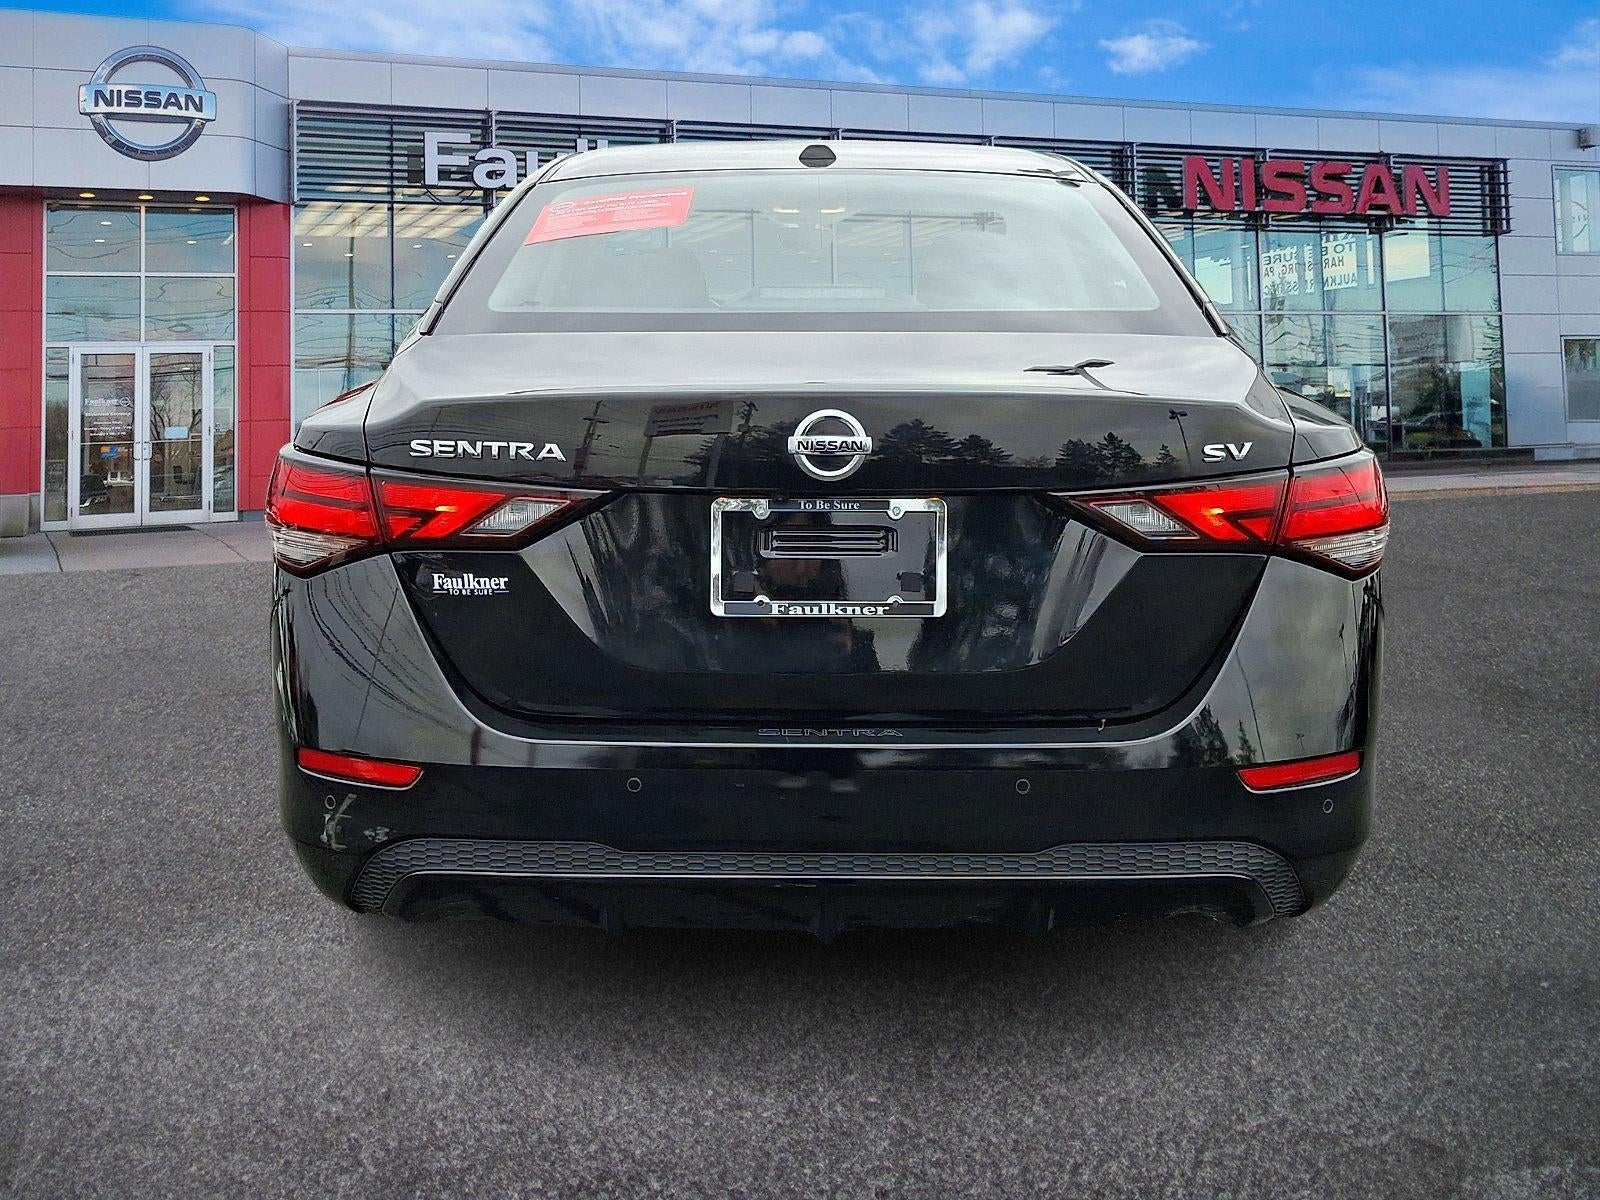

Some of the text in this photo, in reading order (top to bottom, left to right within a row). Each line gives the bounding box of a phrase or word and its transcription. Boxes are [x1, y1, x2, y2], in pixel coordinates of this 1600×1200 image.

[93, 89, 204, 113] NISSAN
[1182, 154, 1450, 216] NISSAN
[410, 440, 567, 462] SENTRA
[797, 440, 863, 453] NISSAN
[1202, 441, 1253, 463] SV
[798, 500, 860, 510] To Be Sure
[432, 573, 509, 589] Faulkner
[769, 602, 890, 616] Faulkner
[757, 728, 904, 738] SENTRA
